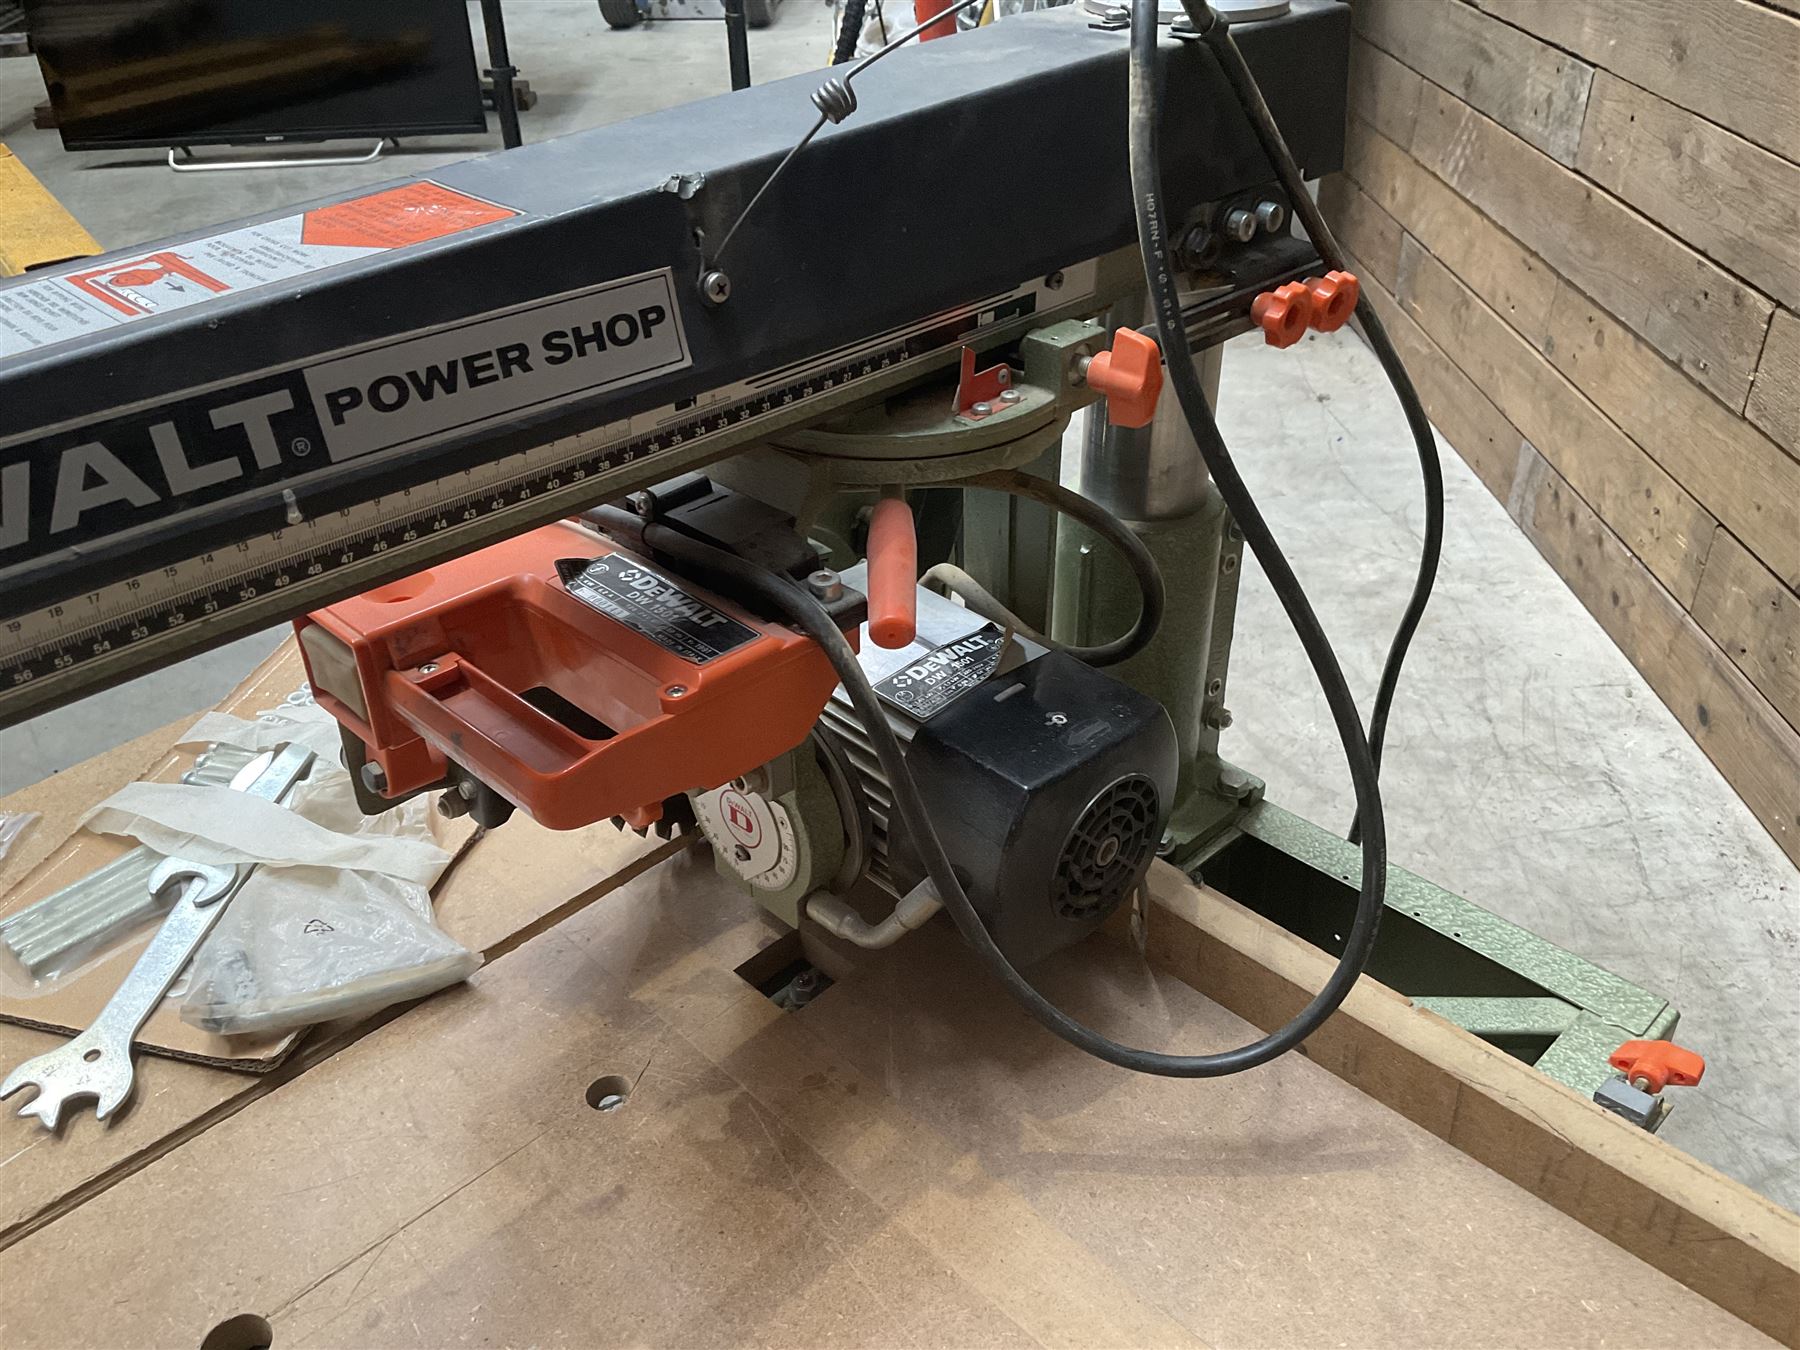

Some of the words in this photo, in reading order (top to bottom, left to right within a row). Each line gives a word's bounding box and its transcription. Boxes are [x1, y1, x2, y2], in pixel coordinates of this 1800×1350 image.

[324, 342, 534, 427] POWER
[541, 304, 667, 367] SHOP
[13, 670, 33, 685] 56
[54, 655, 73, 669] 55
[92, 641, 111, 655] 54
[131, 627, 149, 640] 53
[168, 613, 186, 627] 52
[205, 601, 219, 614] 51
[240, 587, 256, 601] 50
[275, 575, 290, 588] 49
[307, 563, 323, 575] 48
[341, 552, 354, 564] 47
[373, 541, 388, 553] 46
[403, 530, 417, 542] 45
[433, 519, 448, 531] 44
[463, 508, 477, 521] 43
[491, 499, 504, 510] 42
[519, 489, 531, 500] 41
[546, 478, 560, 490] 40
[573, 470, 585, 481] 39
[598, 460, 611, 472] 38
[623, 452, 634, 463] 37
[647, 443, 660, 454] 36
[671, 433, 683, 445] 35
[695, 426, 706, 437] 34
[717, 418, 728, 429] 33
[740, 410, 750, 421] 32
[762, 402, 771, 413] 31
[783, 394, 793, 405] 30
[803, 387, 813, 398] 29
[824, 379, 833, 390] 28
[843, 372, 852, 383] 27
[862, 365, 872, 375] 26
[881, 358, 890, 369] 25
[900, 351, 909, 362] 24
[7, 621, 22, 633] 19
[48, 606, 64, 618] 18
[87, 592, 101, 604] 17
[126, 579, 141, 591] 16
[163, 566, 178, 578] 15
[201, 553, 214, 565] 14
[236, 542, 249, 553] 13
[270, 530, 283, 541] 12
[626, 591, 653, 605] DW
[650, 604, 680, 621] 1501
[925, 670, 947, 685] DW
[951, 656, 975, 669] 1501
[728, 804, 753, 833] D
